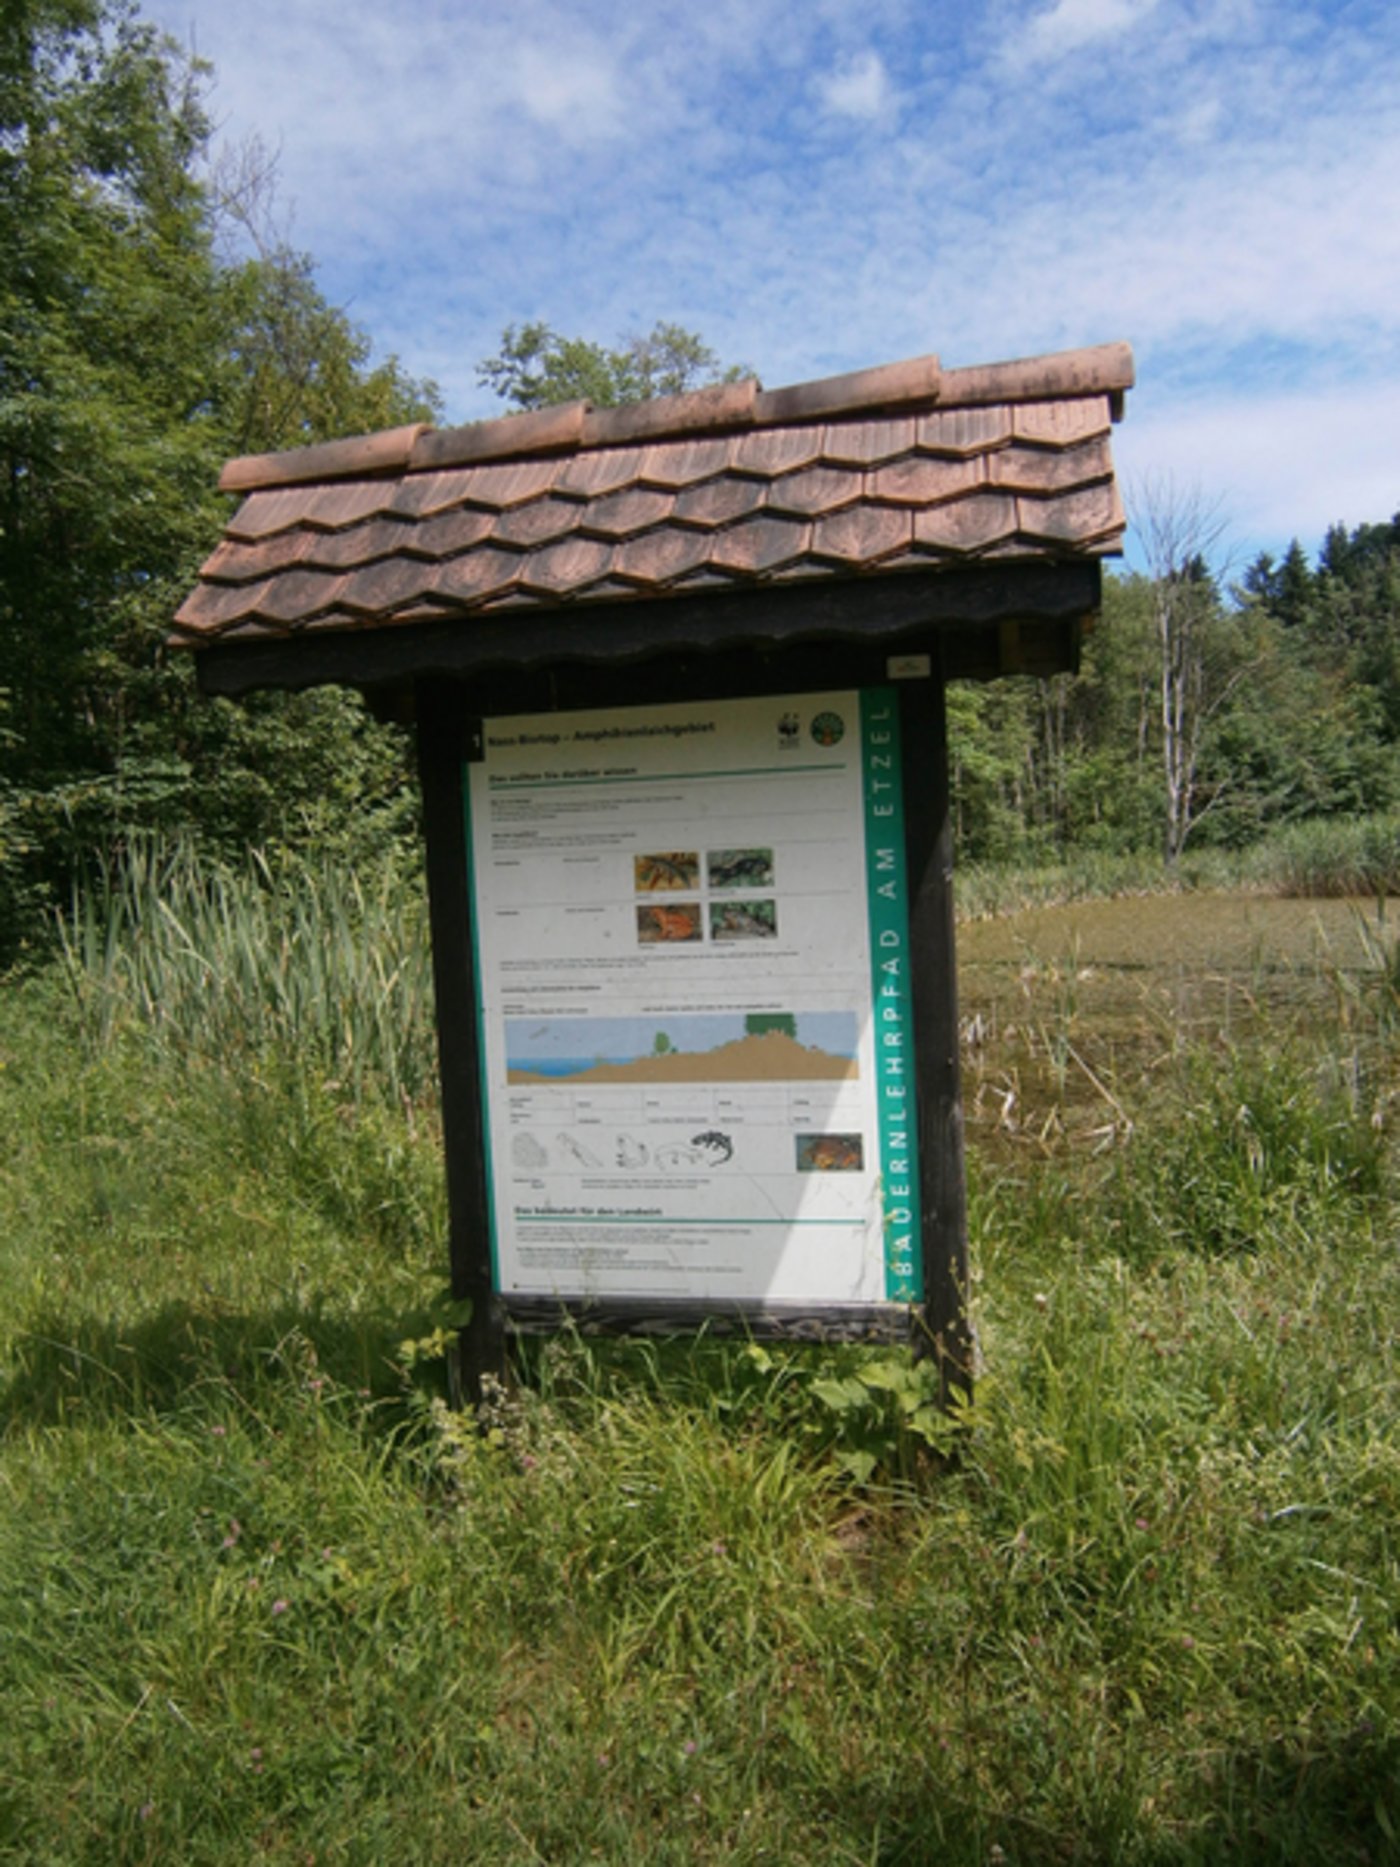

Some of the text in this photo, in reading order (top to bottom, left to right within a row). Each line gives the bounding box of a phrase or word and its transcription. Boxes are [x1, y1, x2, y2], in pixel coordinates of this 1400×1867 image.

[870, 706, 914, 1277] BAUERNLEHRPFAD AM ETZEL
